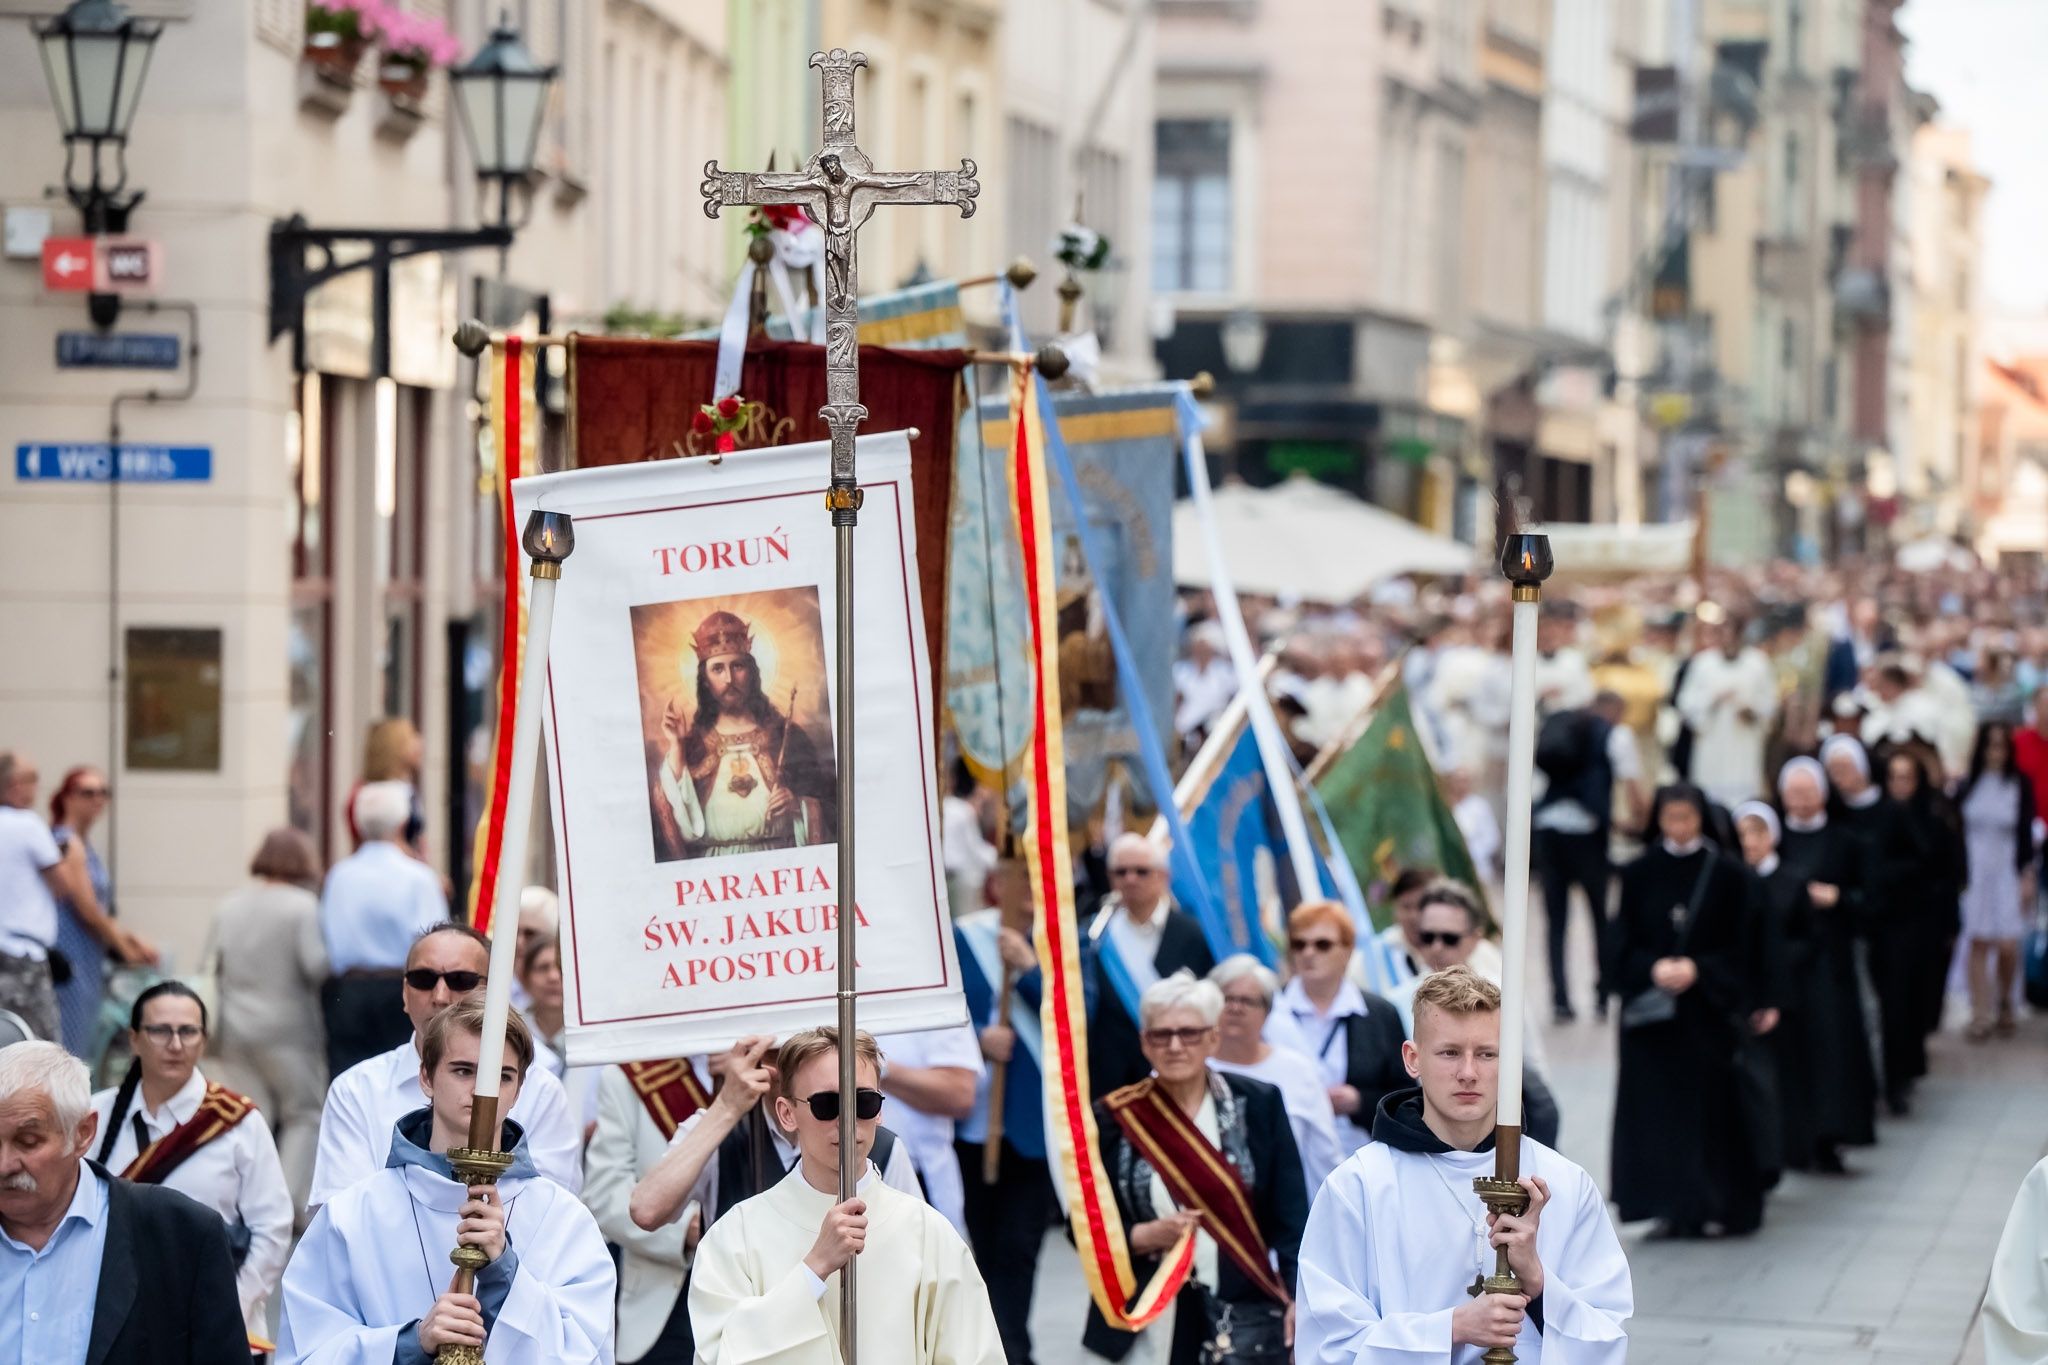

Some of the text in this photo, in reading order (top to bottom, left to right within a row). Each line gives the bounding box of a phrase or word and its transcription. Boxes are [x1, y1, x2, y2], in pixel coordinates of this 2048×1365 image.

[653, 526, 791, 576] TORUŃ
[674, 865, 831, 907] PARAFIA
[644, 915, 709, 951] ŚW.
[661, 945, 861, 989] APOSTOŁ
